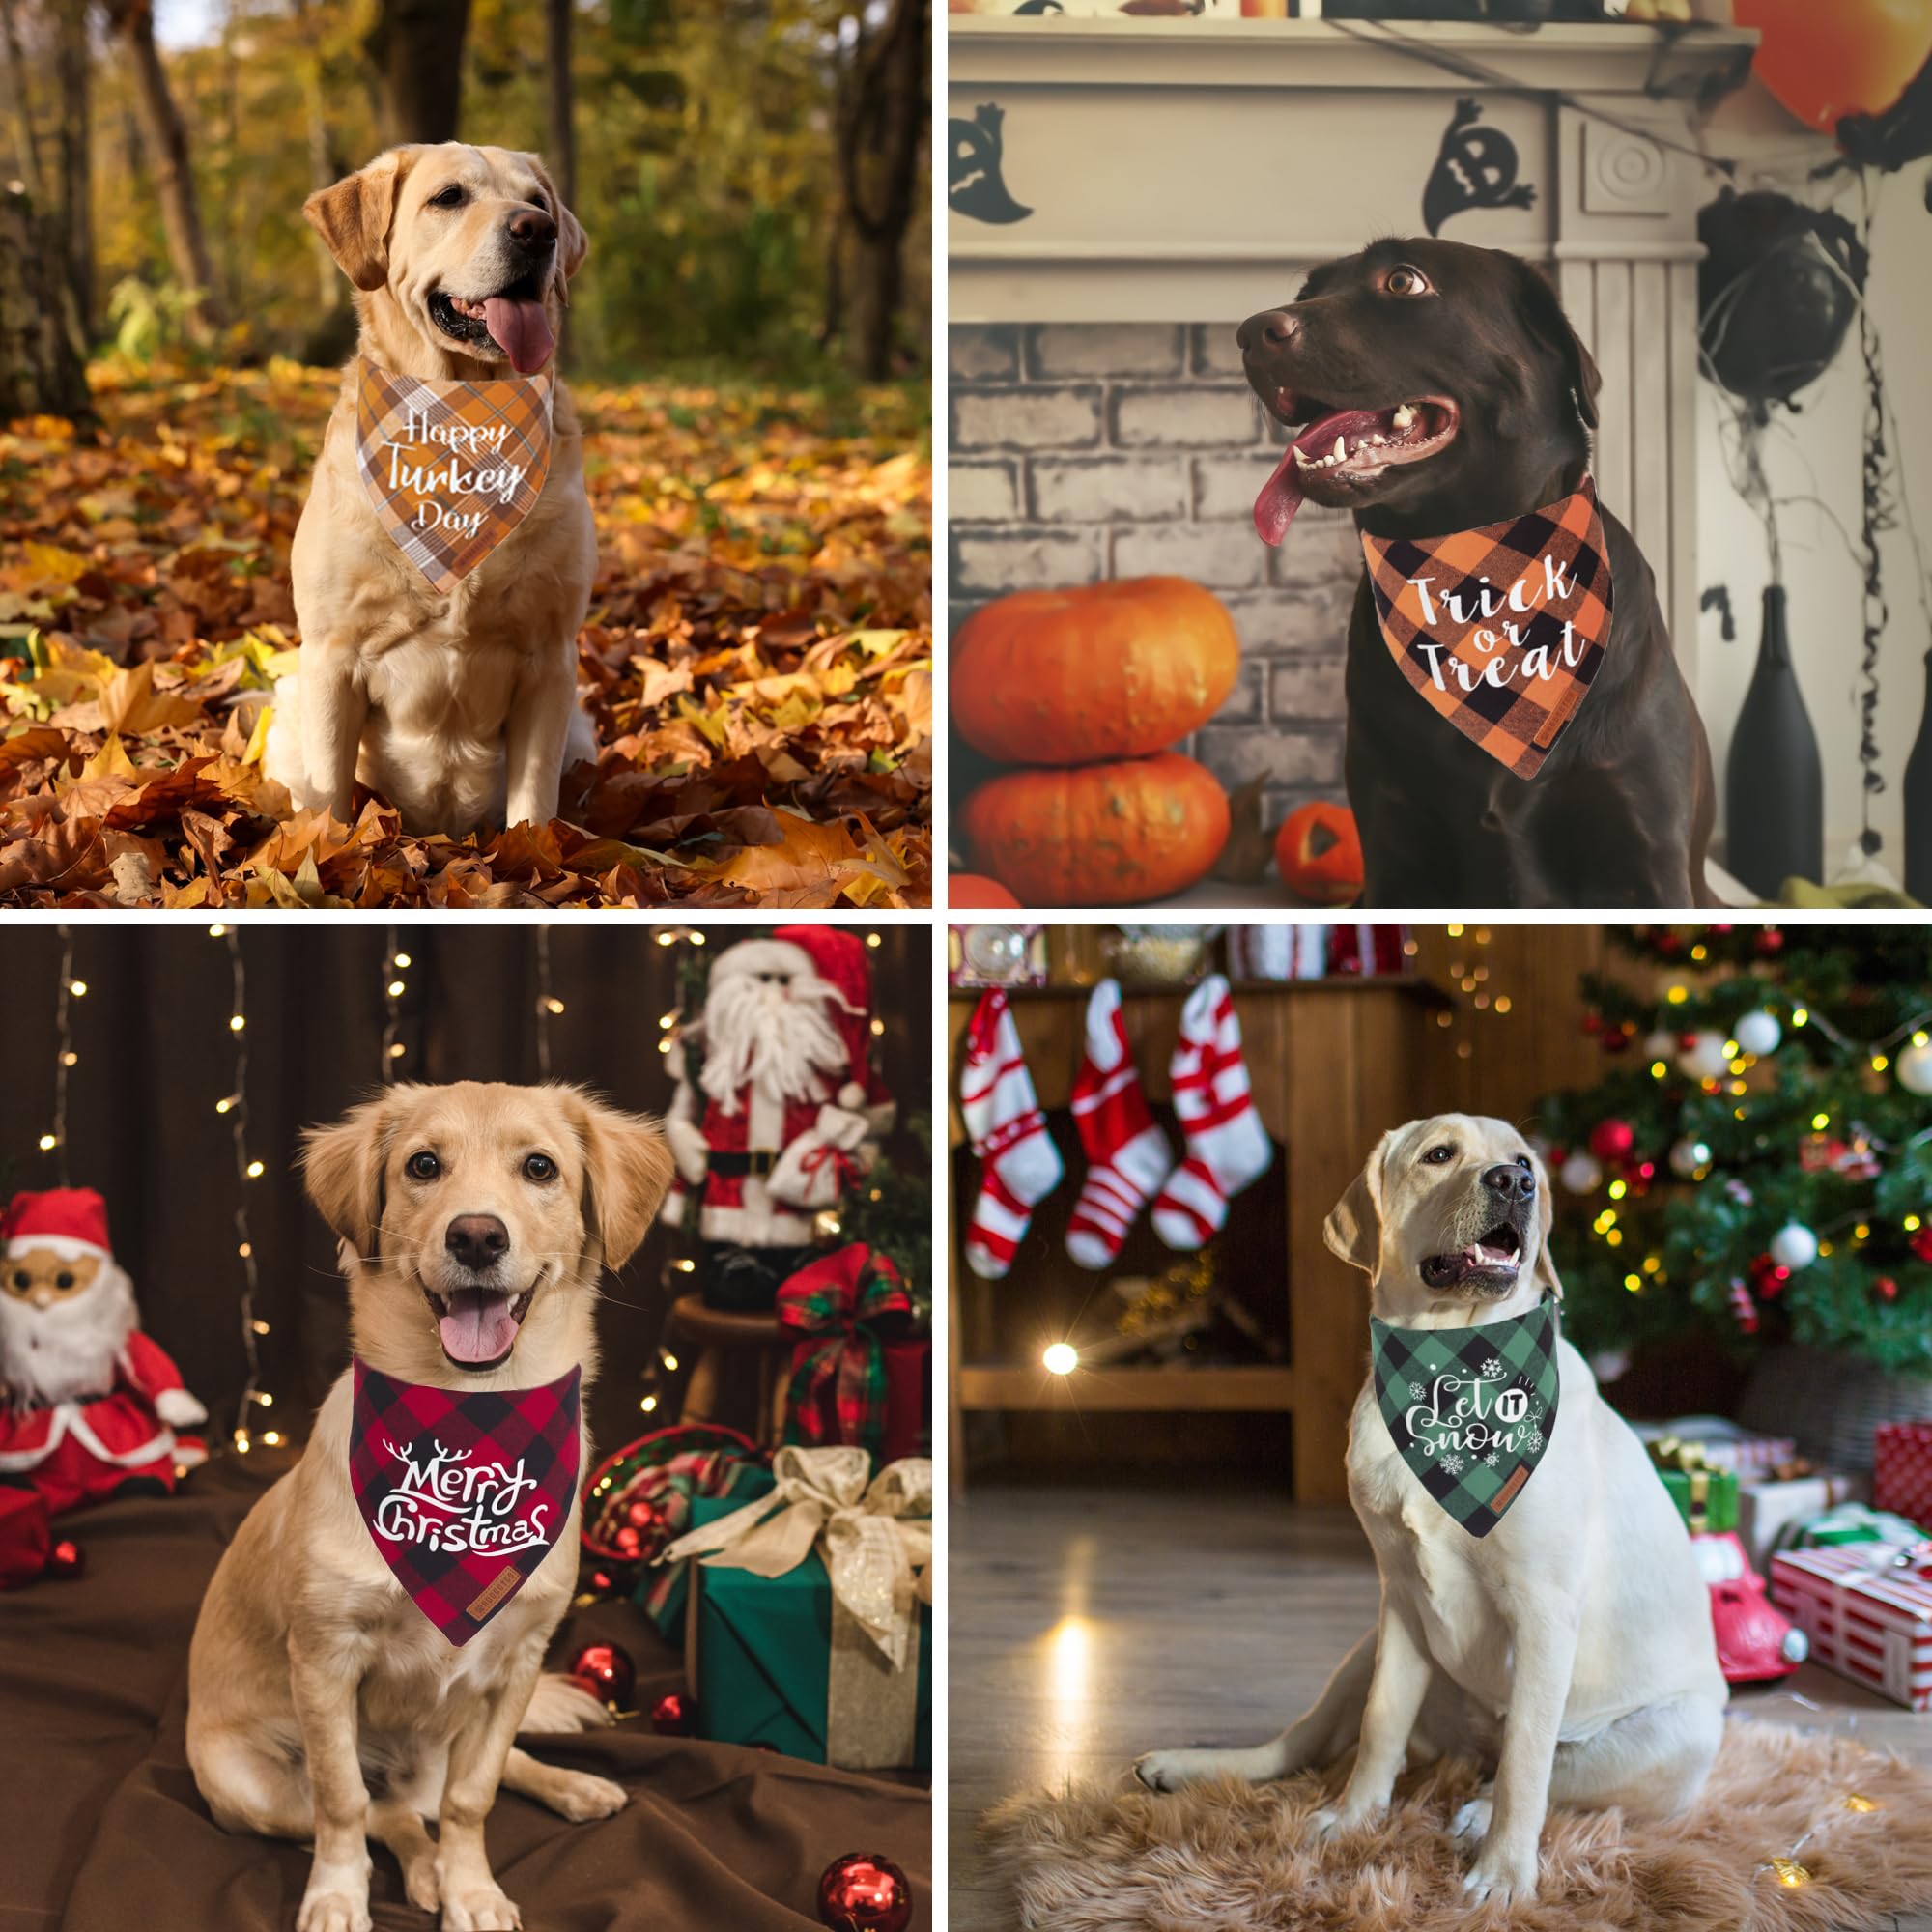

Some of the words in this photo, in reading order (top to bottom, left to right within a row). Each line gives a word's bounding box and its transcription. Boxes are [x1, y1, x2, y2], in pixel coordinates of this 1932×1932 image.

[403, 408, 515, 455] Happy
[381, 440, 527, 504] Turkey
[411, 499, 489, 539] Day
[1406, 554, 1578, 626] Trick
[1417, 620, 1586, 692] Treat
[1473, 620, 1531, 653] or
[1420, 1372, 1507, 1428] Let
[1501, 1392, 1524, 1418] IT
[388, 1455, 537, 1516] Merry
[372, 1494, 550, 1557] Christmas
